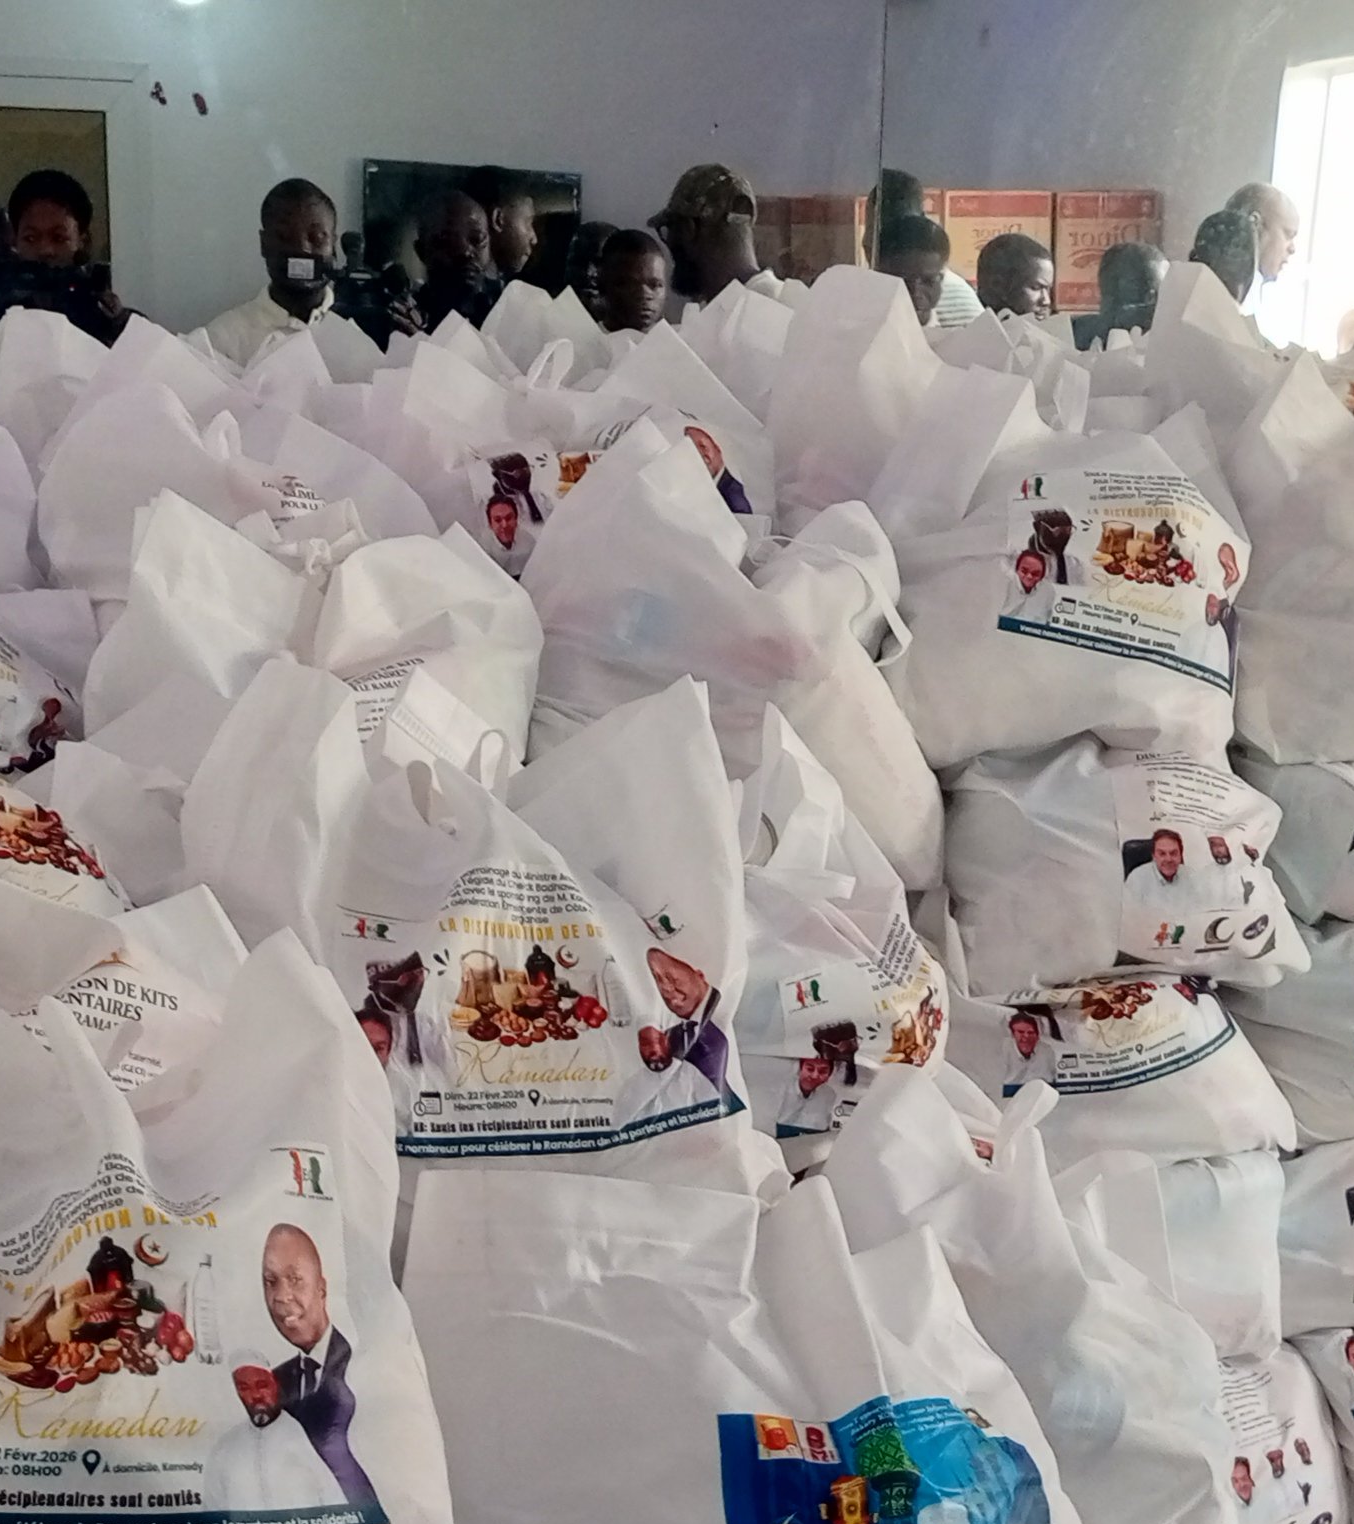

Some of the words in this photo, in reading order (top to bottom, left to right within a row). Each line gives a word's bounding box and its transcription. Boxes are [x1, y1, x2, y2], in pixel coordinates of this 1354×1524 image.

[113, 979, 135, 998] DE
[141, 985, 178, 1011] KITS
[12, 1464, 62, 1476] 08H00
[148, 1489, 202, 1507] conviés
